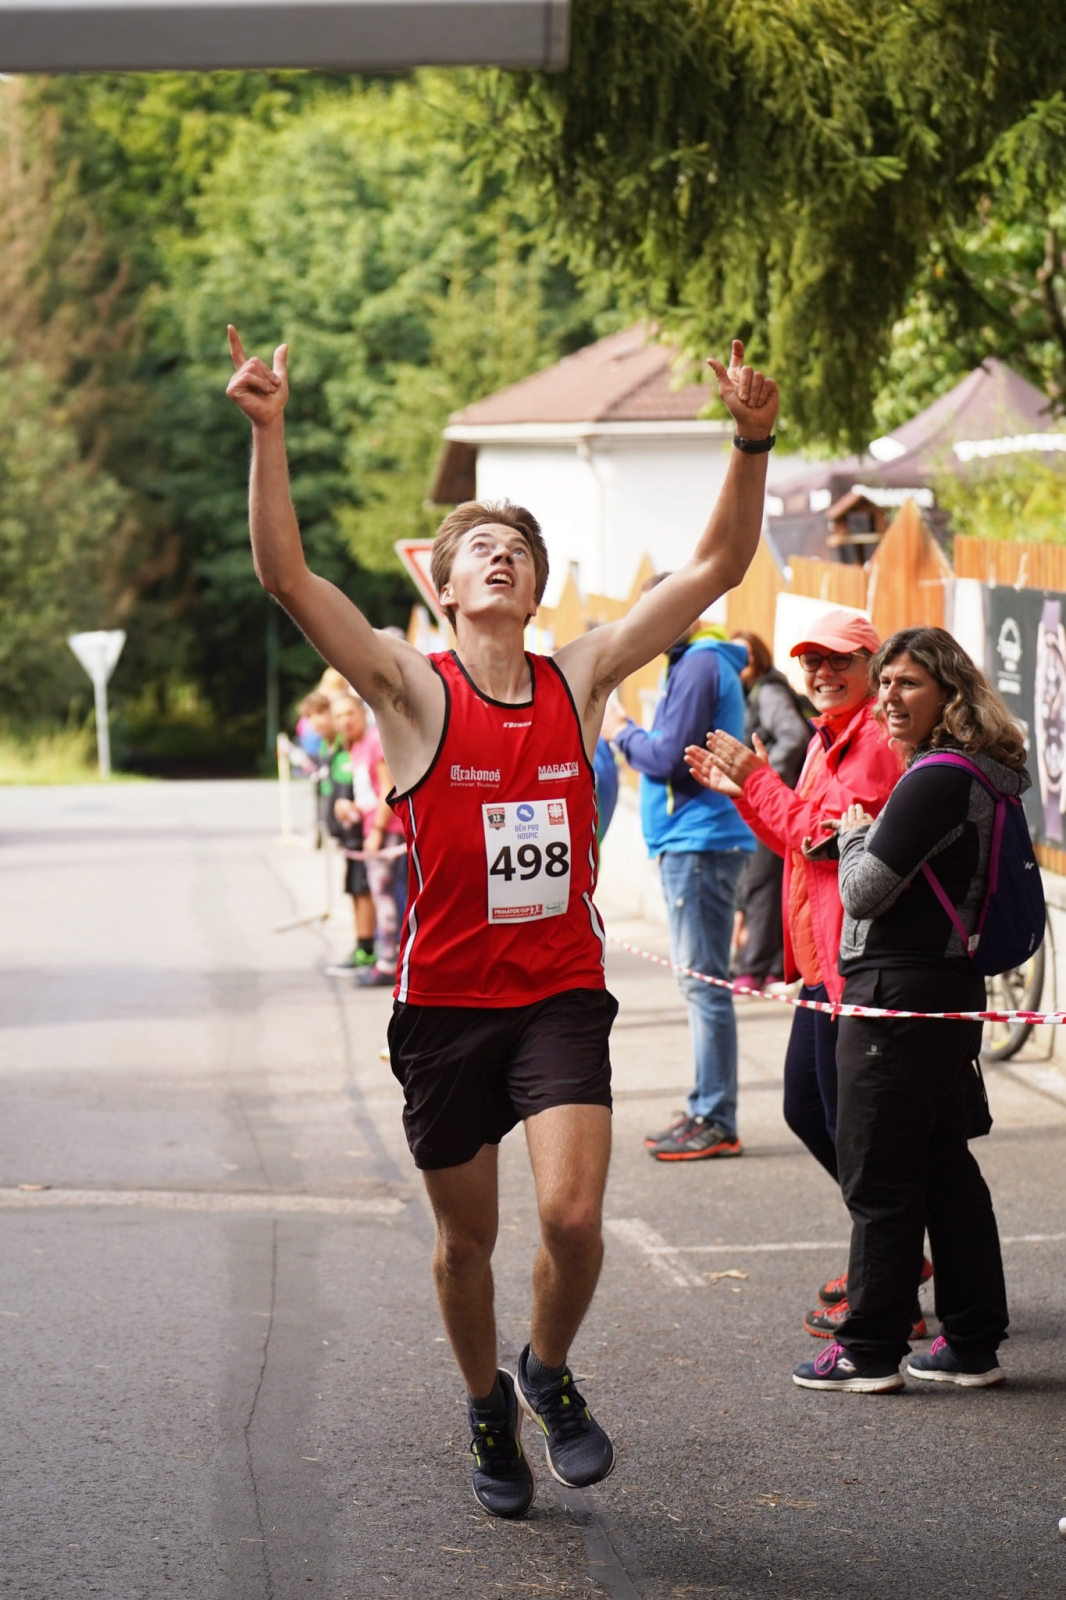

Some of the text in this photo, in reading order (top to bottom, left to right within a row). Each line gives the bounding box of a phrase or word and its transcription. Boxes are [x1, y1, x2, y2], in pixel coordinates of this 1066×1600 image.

[450, 764, 501, 782] Krakonoš
[528, 823, 539, 831] PRO
[517, 831, 539, 840] HOSPIC
[489, 841, 570, 882] 498
